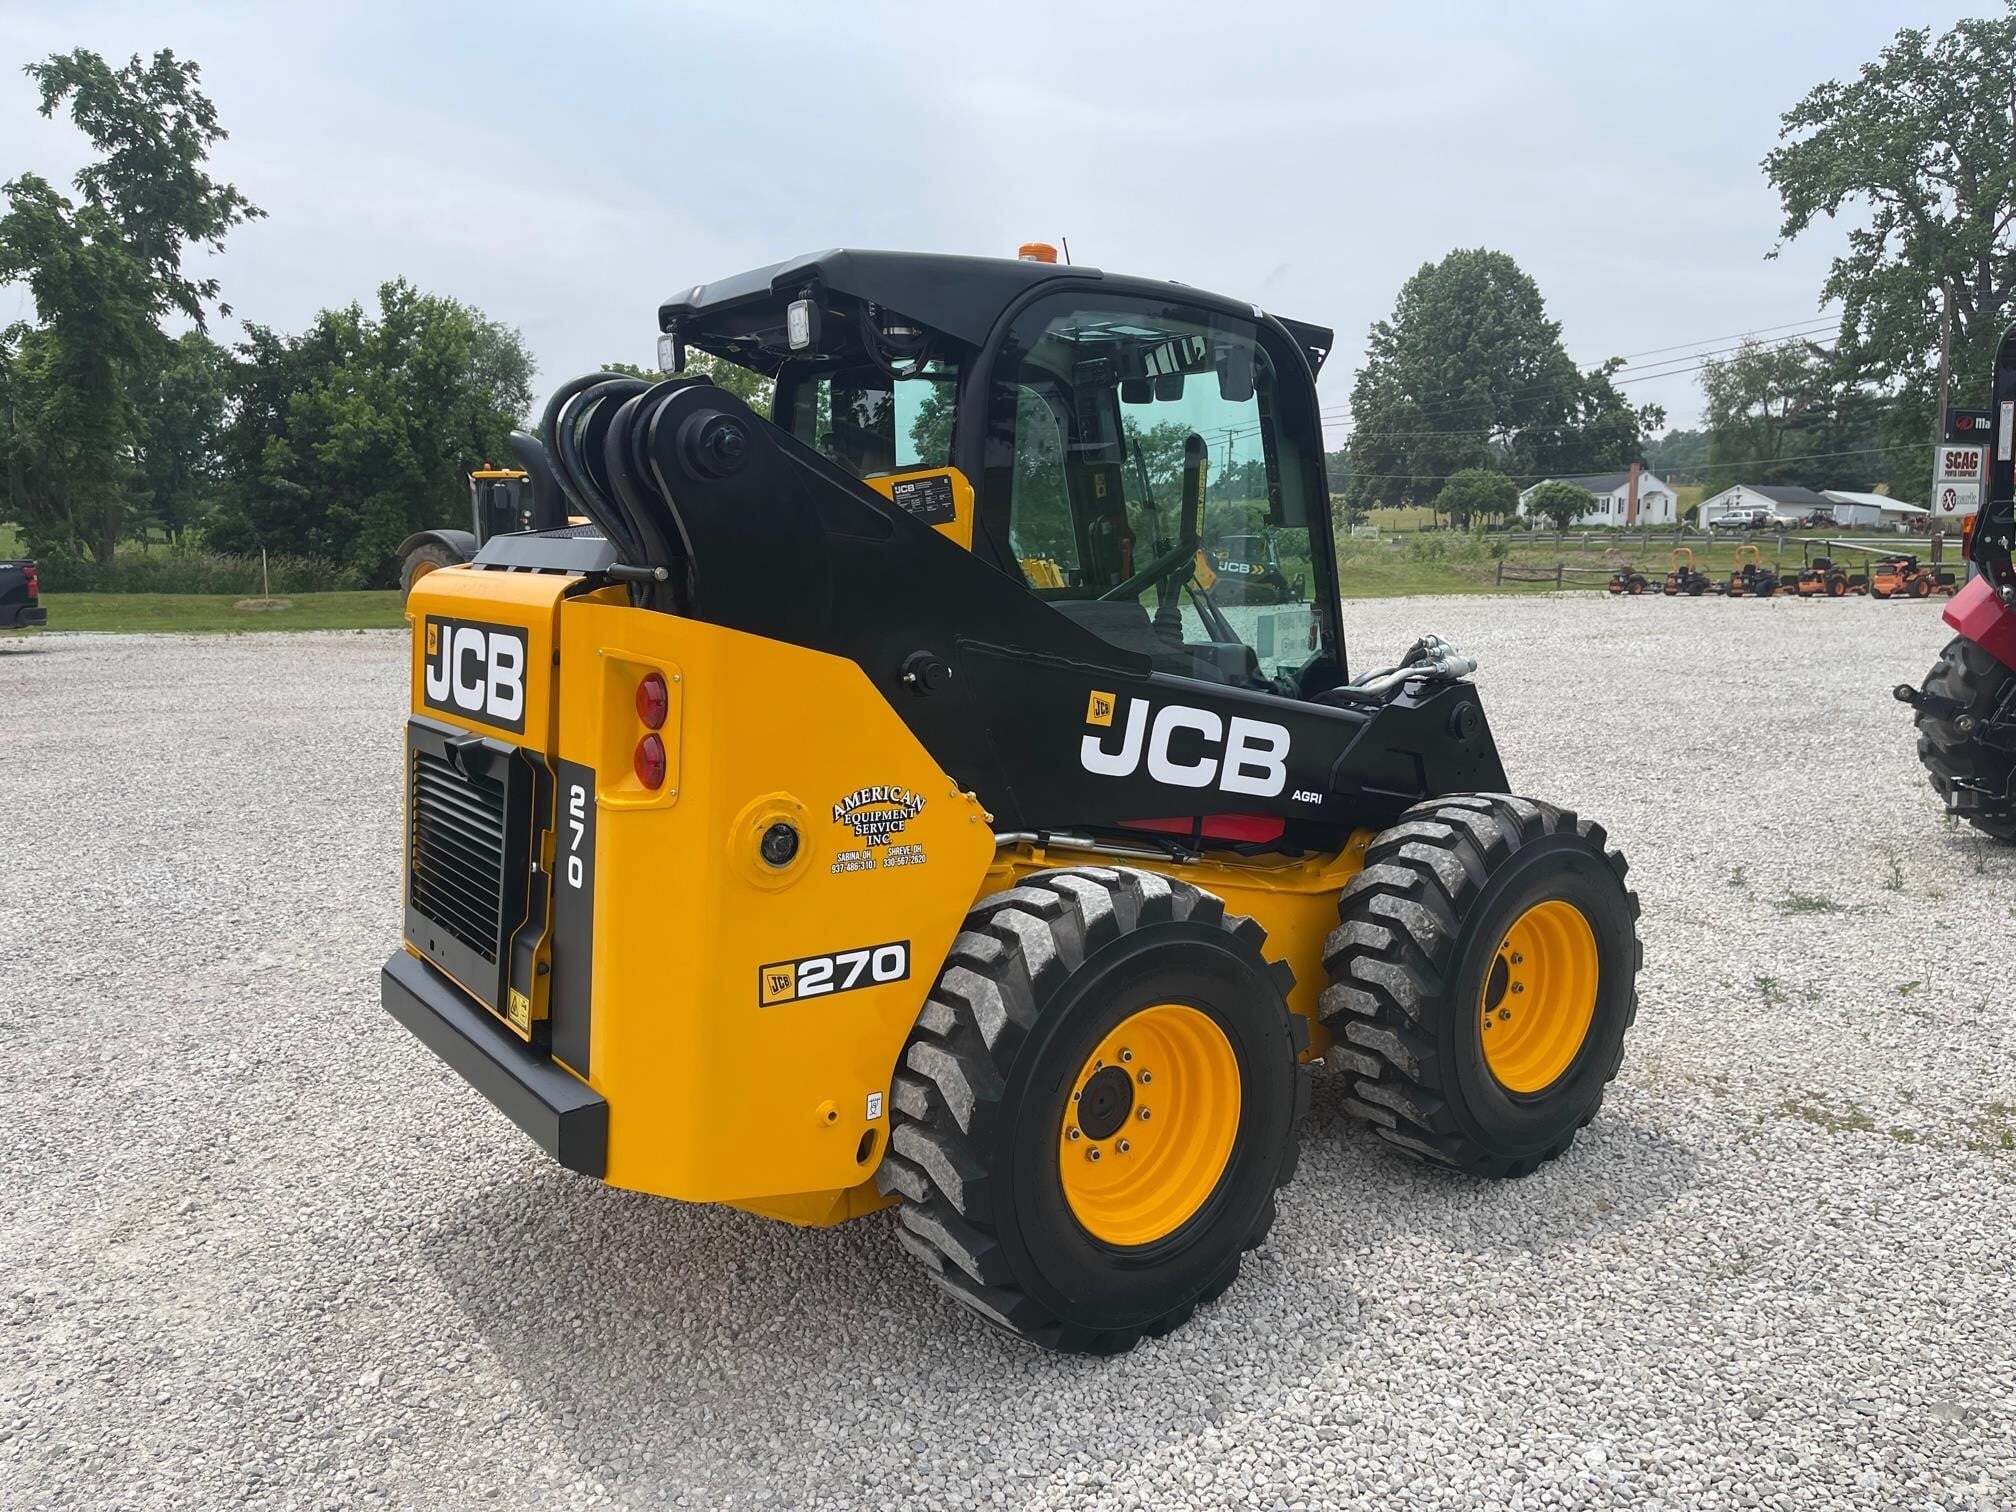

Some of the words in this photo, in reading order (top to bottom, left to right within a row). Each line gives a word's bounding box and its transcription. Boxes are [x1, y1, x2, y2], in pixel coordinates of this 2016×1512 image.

[1975, 417, 1991, 430] Ma
[1945, 451, 1979, 470] SCAG
[895, 484, 915, 494] JCB
[1218, 562, 1250, 574] JCB
[426, 626, 524, 721] JCB
[1095, 699, 1110, 715] JCB
[1080, 697, 1291, 798] JCB
[833, 785, 925, 822] AMERICAN
[1291, 789, 1323, 805] AGRI
[844, 808, 915, 825] EQUIPMENT
[855, 820, 905, 836] SERVICE
[567, 784, 586, 889] 270
[862, 850, 872, 860] OH
[913, 844, 922, 854] OH
[798, 945, 905, 997] 270
[771, 976, 790, 992] JCB
